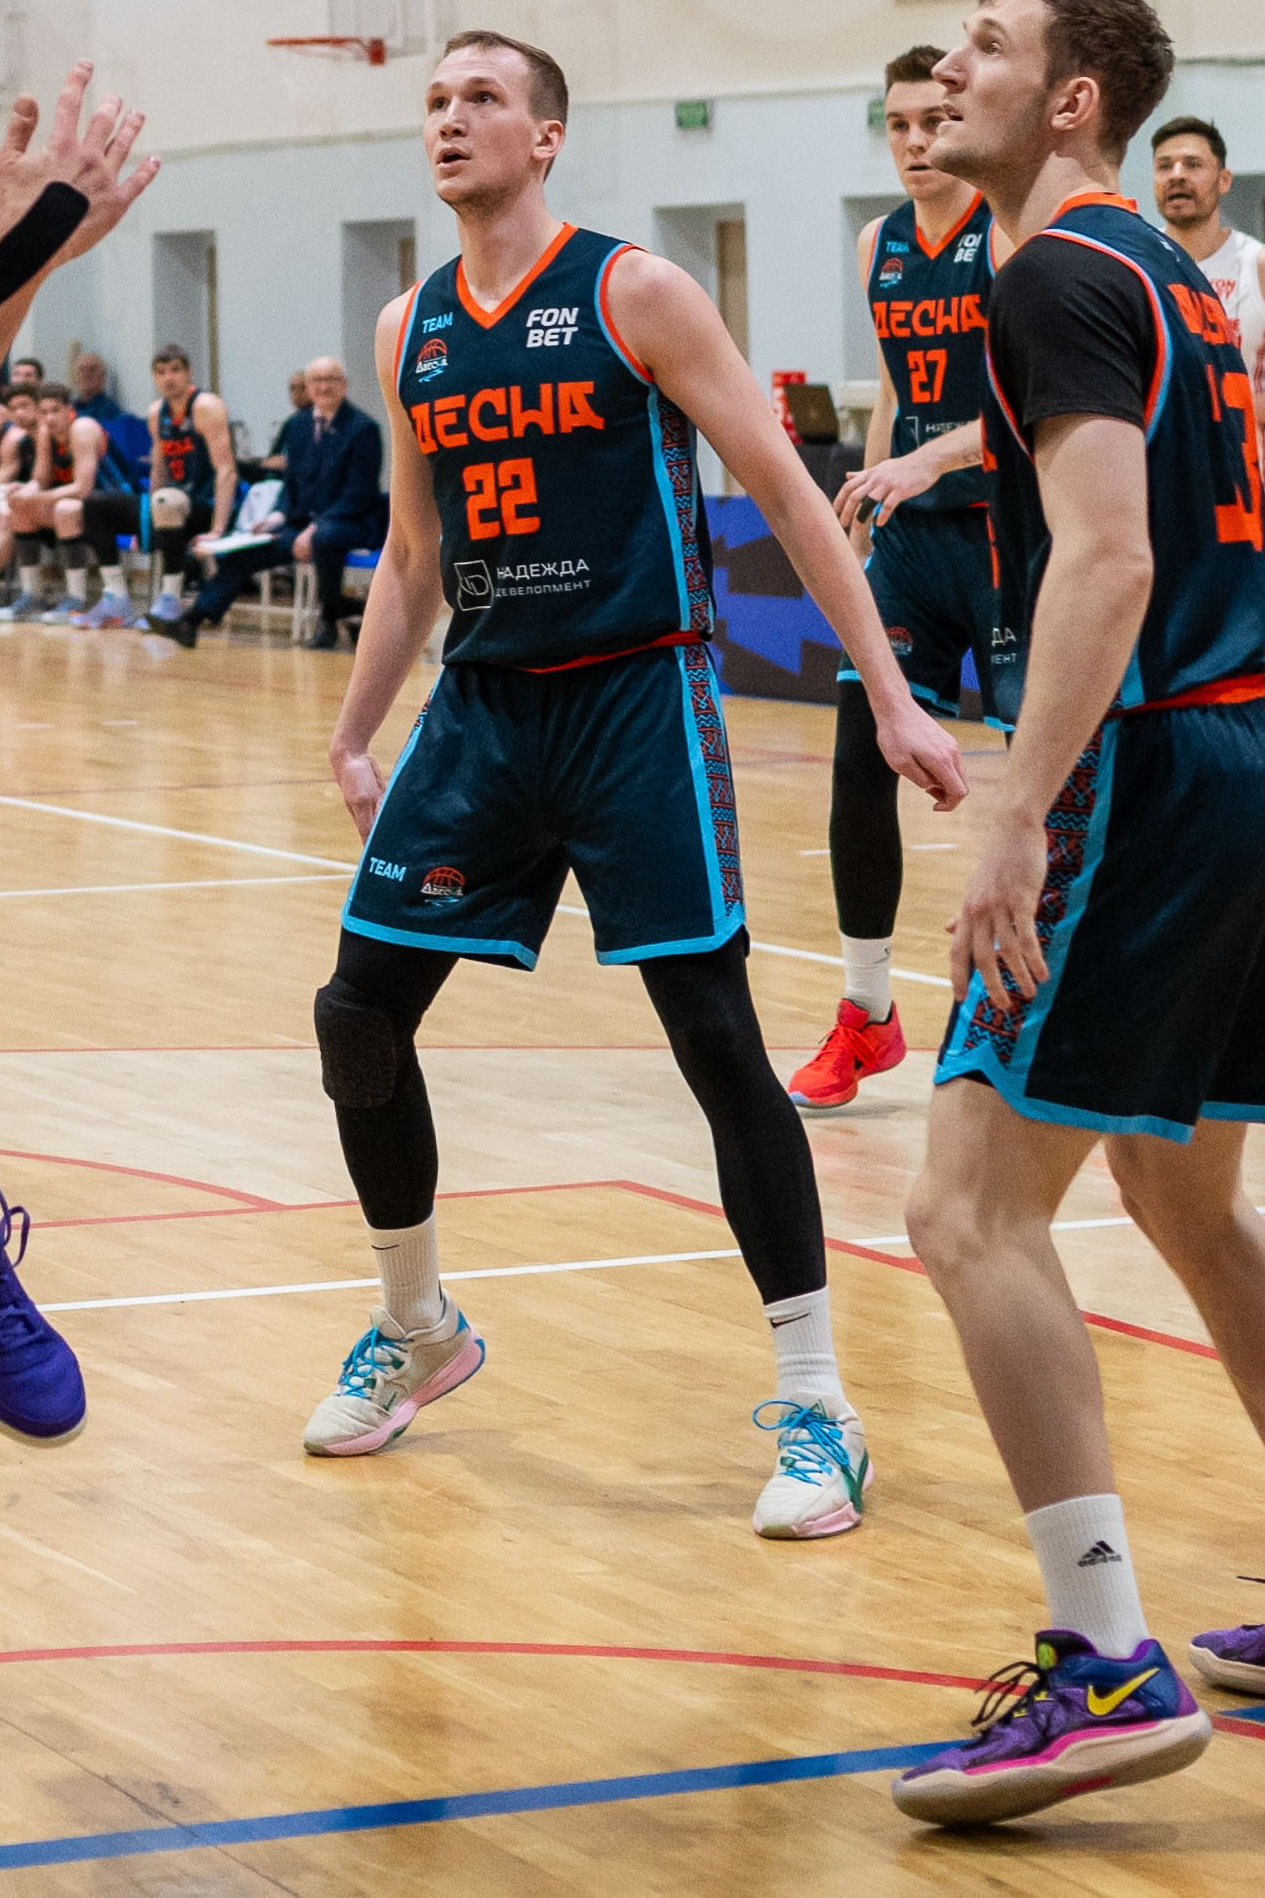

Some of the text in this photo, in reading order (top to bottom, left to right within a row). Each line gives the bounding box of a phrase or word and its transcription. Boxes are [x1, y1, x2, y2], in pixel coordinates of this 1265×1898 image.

[422, 312, 453, 334] TEAM
[526, 308, 579, 328] FON
[872, 294, 989, 339] ДЕСНА
[526, 327, 579, 348] BET
[906, 349, 947, 403] 27
[410, 381, 606, 455] ДЕСНА
[462, 457, 541, 541] 22
[497, 559, 590, 581] НАДЕЖДА
[494, 579, 592, 598] ДЕВЕЛОПМЕНТ
[369, 856, 407, 882] TEAM
